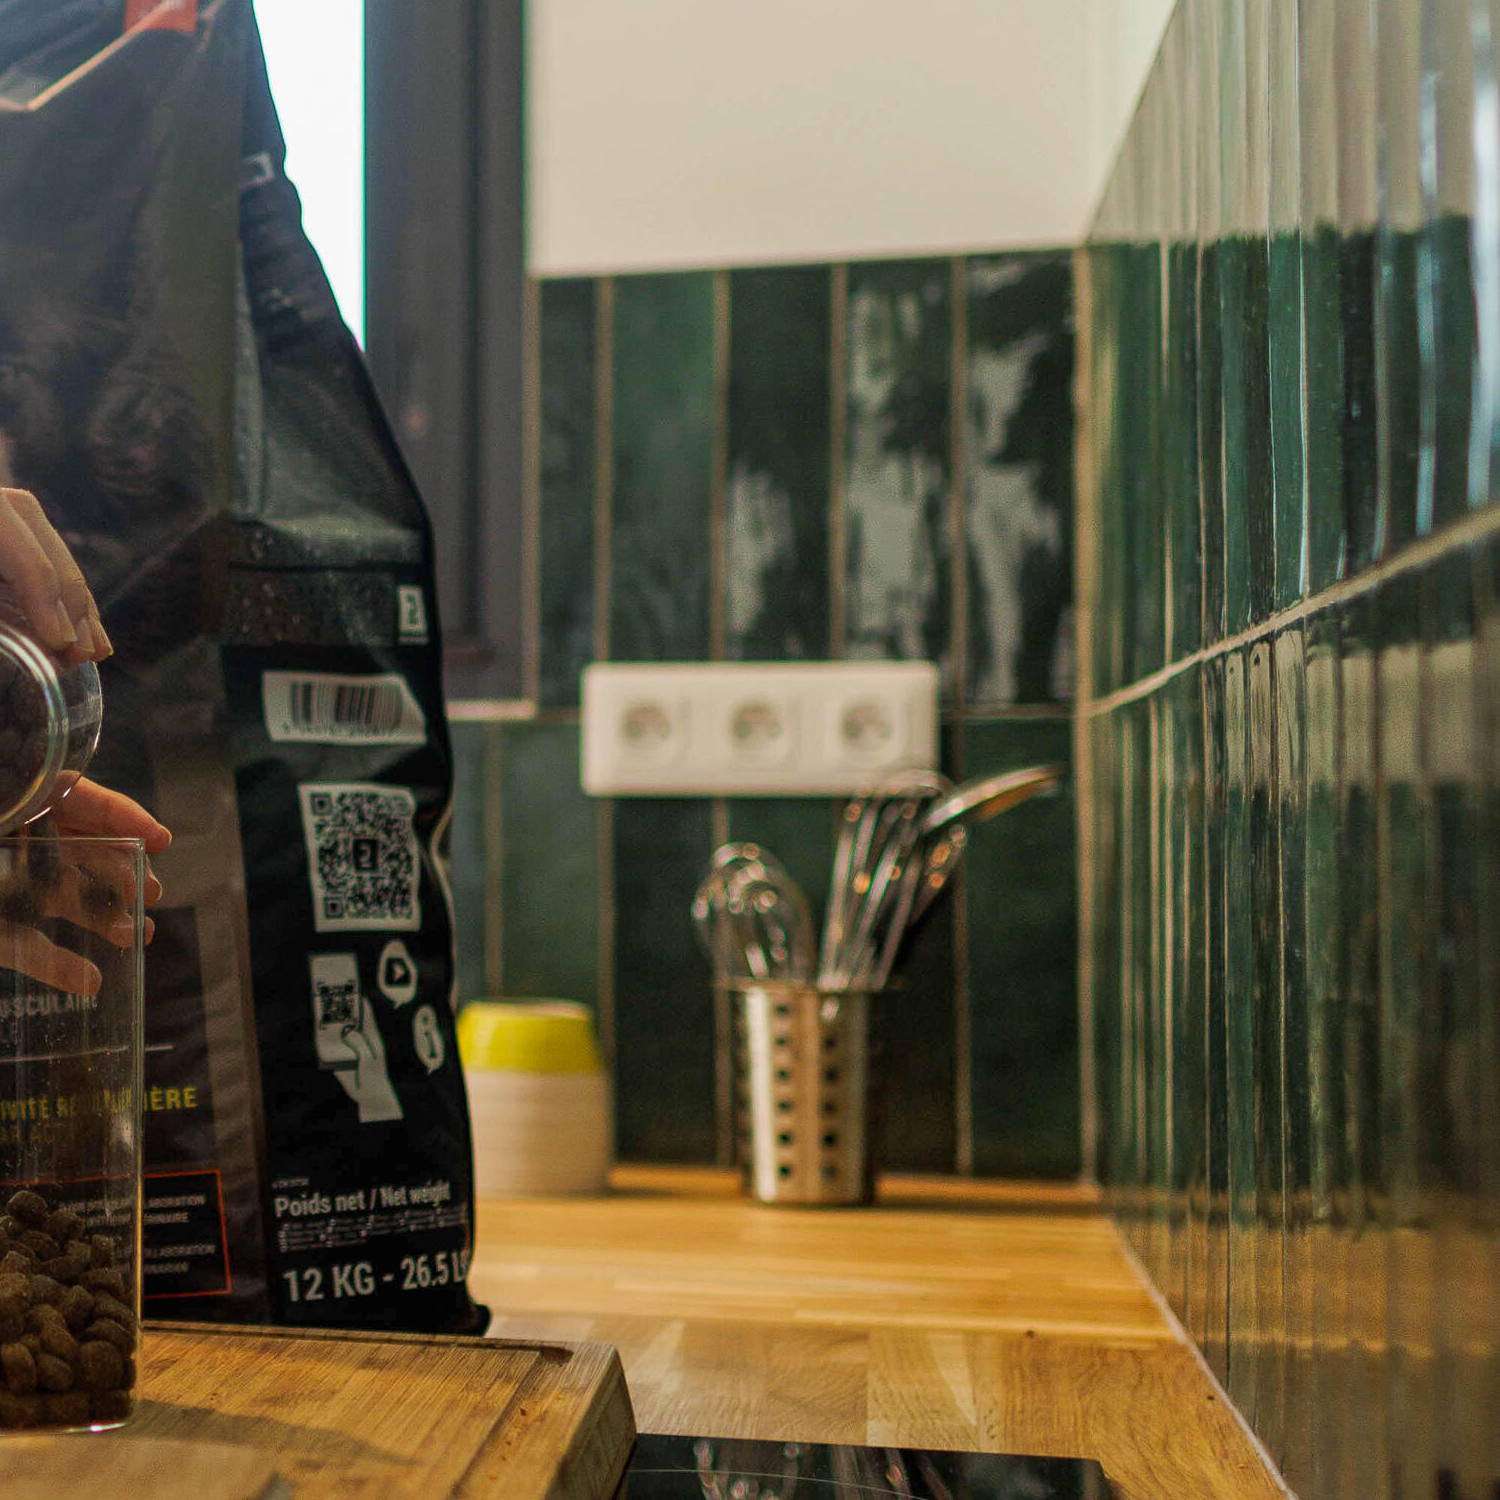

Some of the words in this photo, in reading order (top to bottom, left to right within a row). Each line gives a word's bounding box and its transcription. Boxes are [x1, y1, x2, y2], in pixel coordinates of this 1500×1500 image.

[274, 1190, 332, 1218] Poids
[335, 1189, 365, 1211] net
[380, 1185, 408, 1207] Net
[409, 1178, 453, 1207] weight
[281, 1267, 325, 1303] 12
[331, 1260, 376, 1299] KG
[400, 1251, 450, 1291] 26.5
